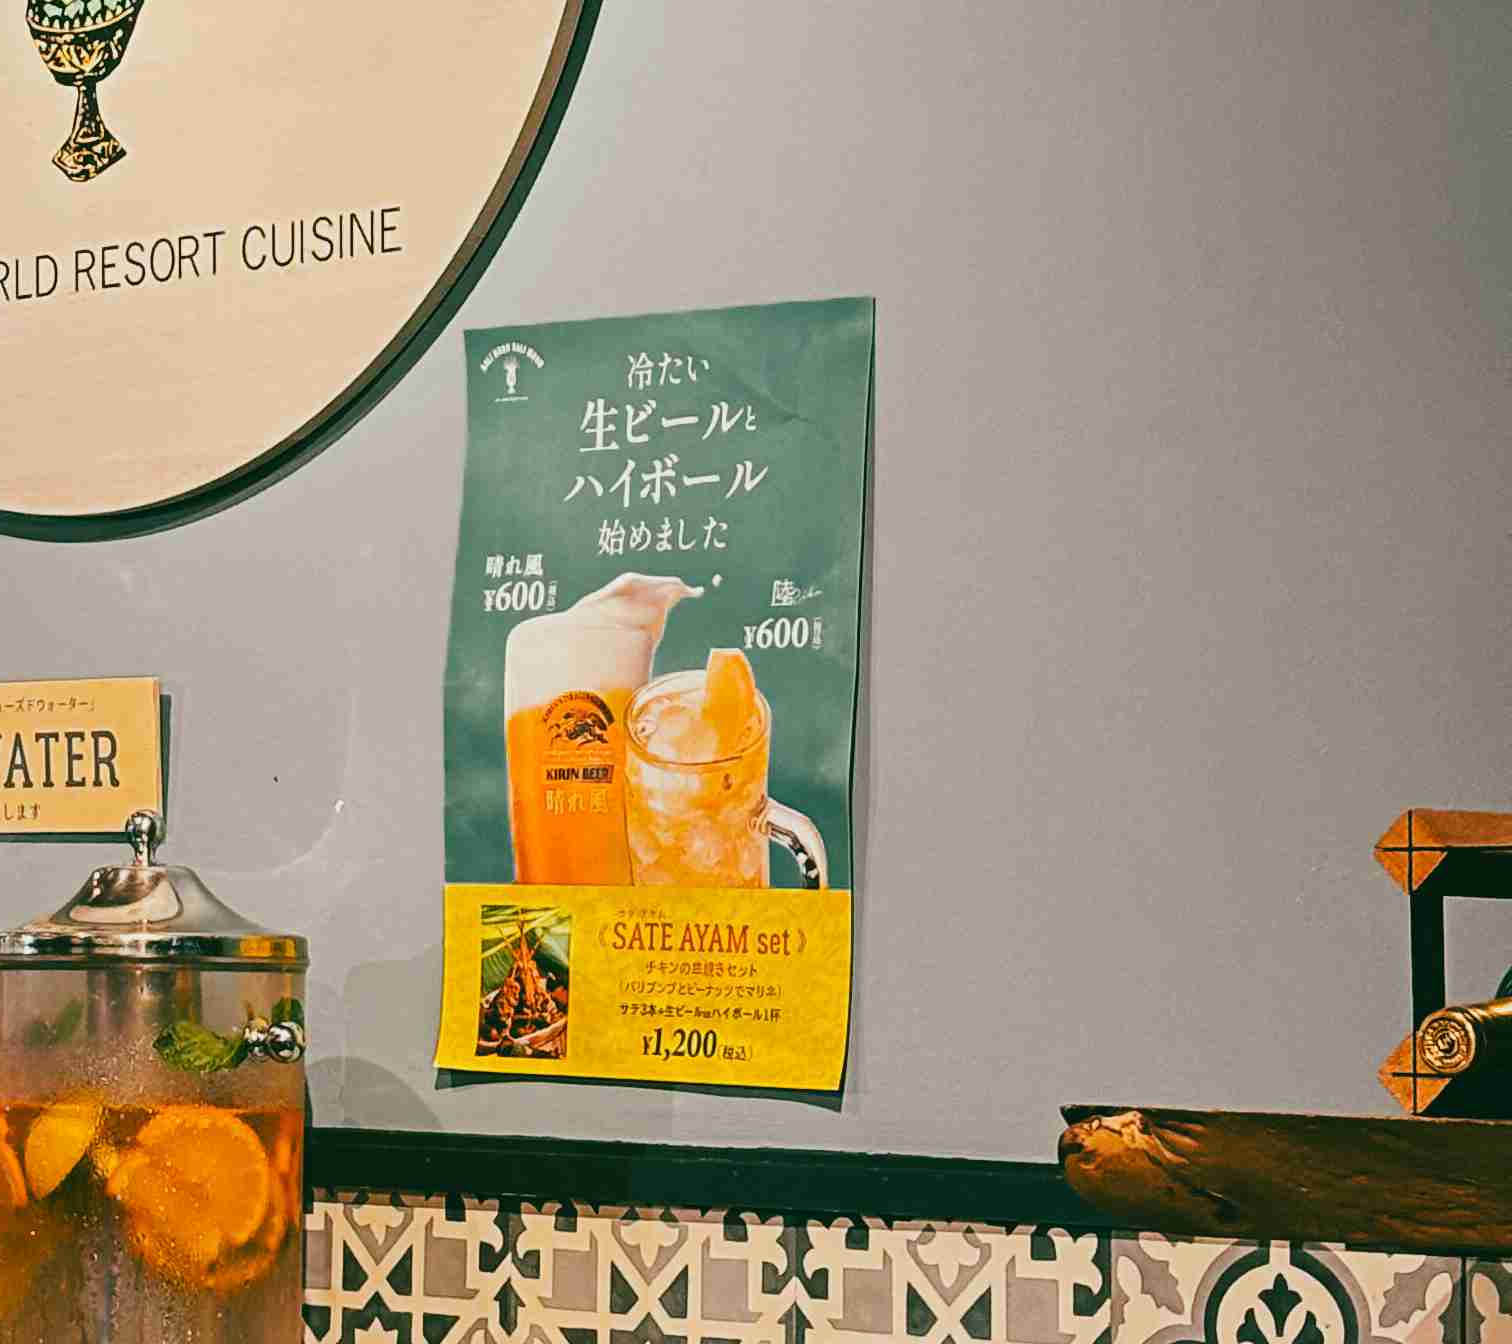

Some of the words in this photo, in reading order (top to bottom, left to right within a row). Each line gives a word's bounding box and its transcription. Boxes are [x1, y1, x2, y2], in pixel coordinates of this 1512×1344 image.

[74, 230, 227, 293] RESORT
[241, 206, 403, 271] CUISINE
[626, 352, 711, 391] 冷たい
[578, 398, 758, 453] 生ビールと
[563, 453, 769, 508] ハイボール
[598, 516, 729, 556] 始めました
[545, 767, 580, 781] KIRIN
[612, 921, 674, 951] SATE
[678, 922, 749, 955] AYAM
[757, 928, 791, 956] set
